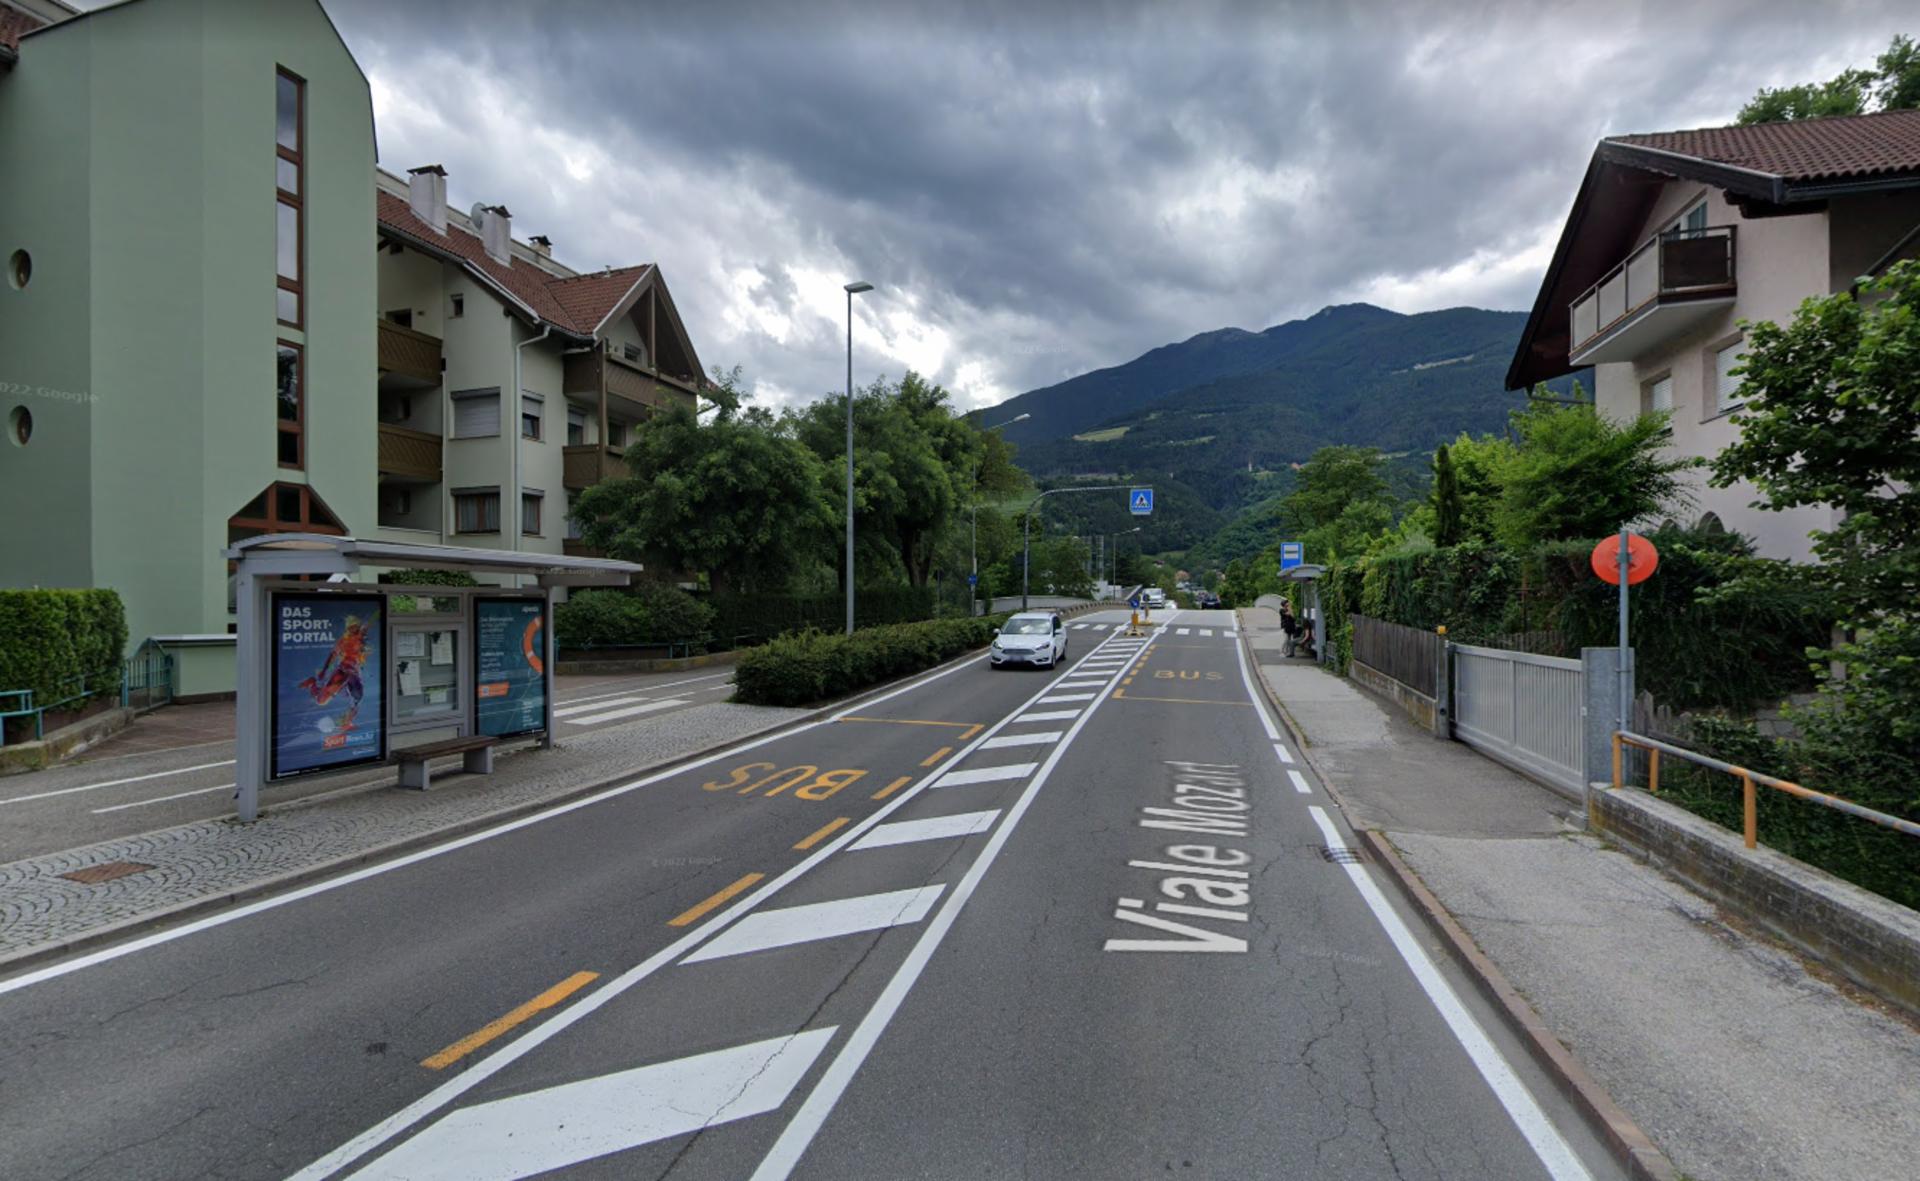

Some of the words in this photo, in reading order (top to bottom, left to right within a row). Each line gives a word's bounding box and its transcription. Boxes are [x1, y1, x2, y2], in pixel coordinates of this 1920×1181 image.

[282, 606, 312, 618] DAS
[282, 619, 333, 631] SPORT-
[282, 631, 335, 643] PORTAL
[1154, 669, 1225, 681] BUS
[702, 762, 869, 801] BUS
